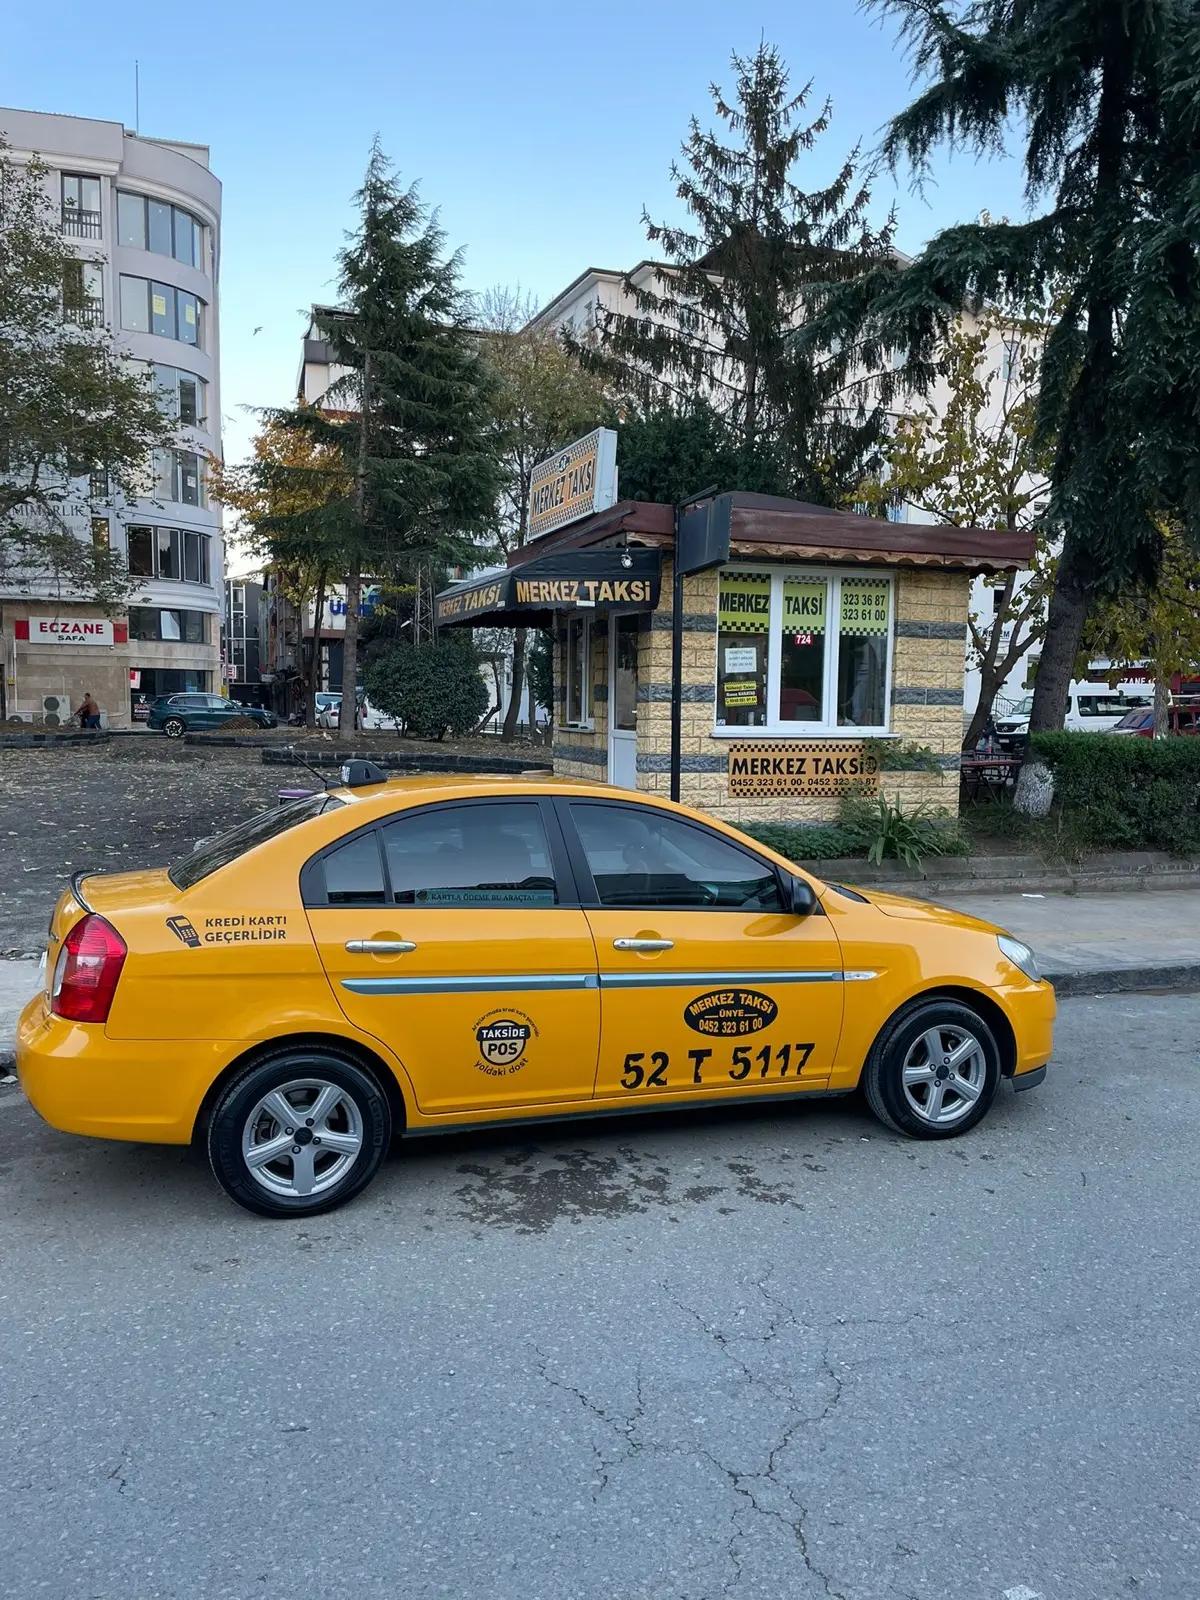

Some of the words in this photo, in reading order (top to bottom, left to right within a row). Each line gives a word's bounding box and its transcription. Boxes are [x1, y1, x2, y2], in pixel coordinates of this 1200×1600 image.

[532, 475, 567, 516] MERKEZ
[516, 580, 580, 603] MERKEZ
[439, 596, 463, 618] MERKEZ
[719, 592, 770, 614] MERKEZ
[785, 593, 823, 616] TAKSİ
[843, 593, 859, 606] 323
[862, 594, 873, 606] 36
[875, 595, 886, 607] 87
[843, 608, 859, 621] 323
[862, 609, 872, 621] 61
[875, 609, 886, 622] 00
[39, 622, 104, 635] ECZANE
[796, 634, 812, 645] 724
[732, 757, 807, 775] MERKEZ
[730, 778, 754, 787] 0452
[756, 778, 774, 787] 323
[776, 778, 787, 787] 61
[807, 778, 830, 786] 0452
[833, 778, 849, 786] 323
[865, 778, 877, 786] 87
[491, 893, 502, 901] BU
[205, 915, 245, 928] KREDİ
[248, 915, 287, 926] KARTI
[204, 928, 287, 944] GEÇERLİDİR
[689, 993, 735, 1017] MERKEZ
[719, 1008, 744, 1018] ÜNYE
[482, 1027, 526, 1039] TAKSİDE
[699, 1019, 719, 1033] 0452
[721, 1021, 737, 1034] 323
[739, 1020, 749, 1033] 61
[752, 1017, 763, 1030] 00
[487, 1042, 518, 1056] POS
[474, 1060, 506, 1077] yoldaki
[508, 1057, 529, 1074] dost
[620, 1051, 670, 1090] 52
[688, 1048, 713, 1084] T
[728, 1042, 815, 1080] 5117
